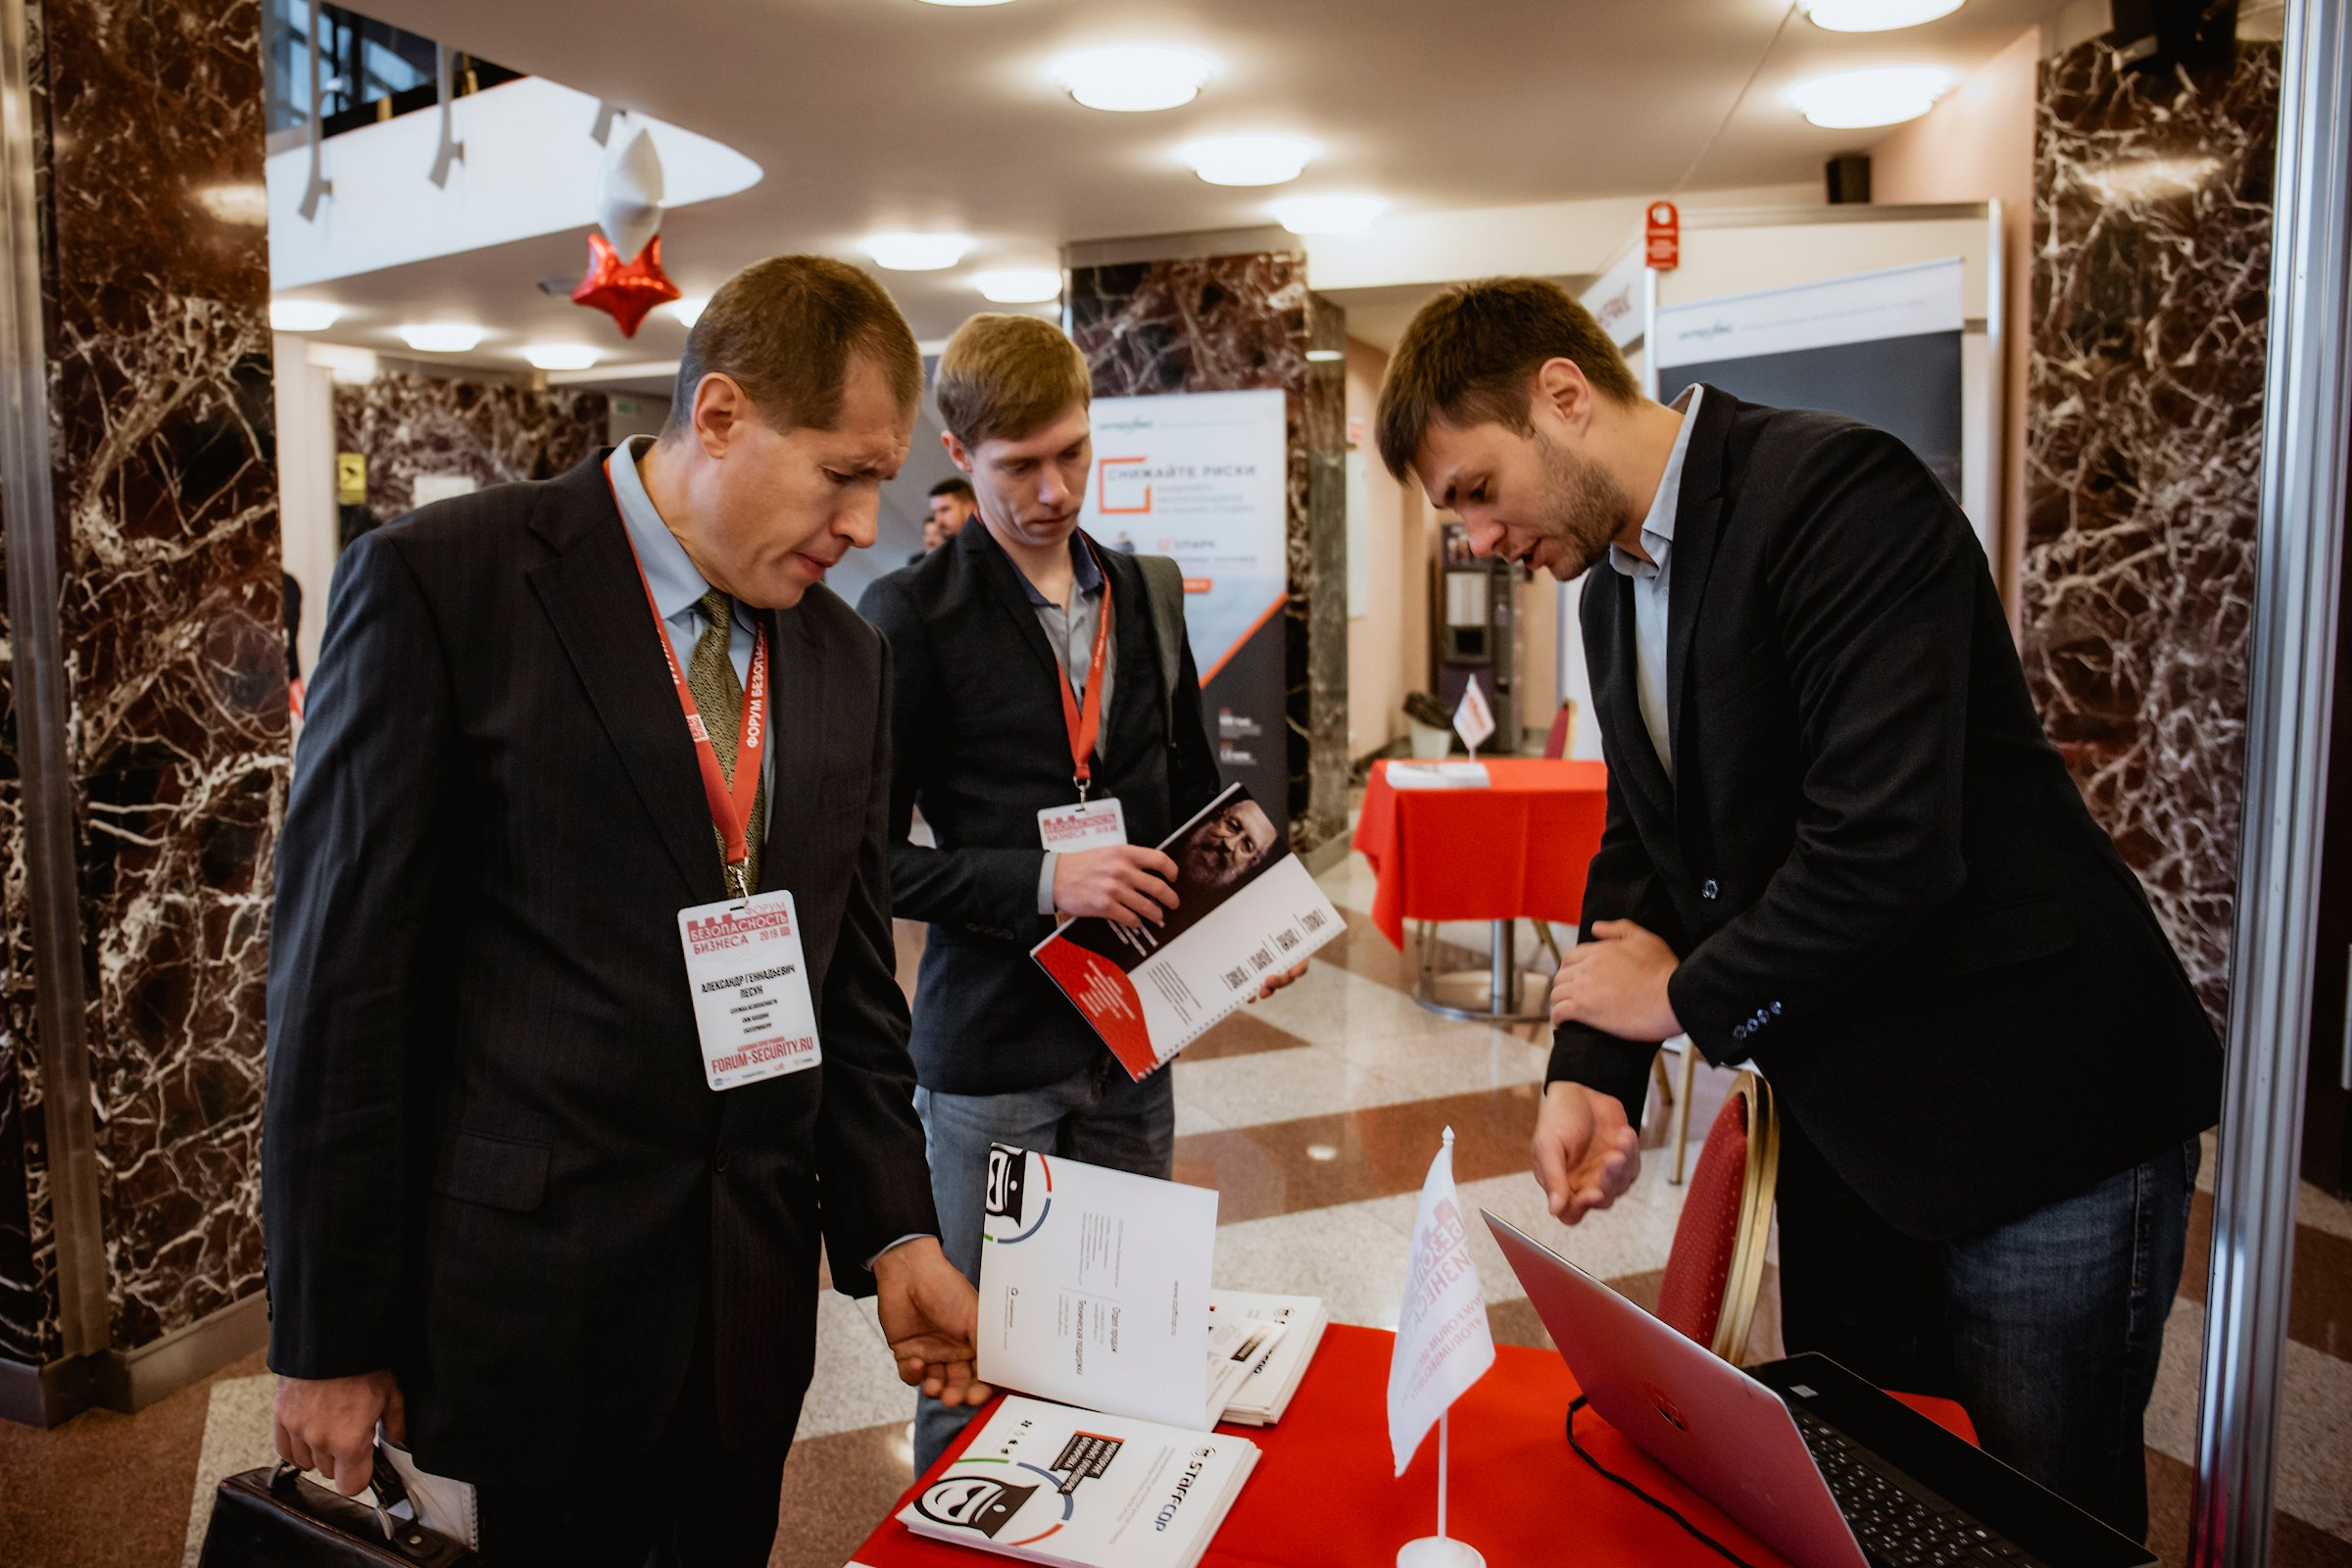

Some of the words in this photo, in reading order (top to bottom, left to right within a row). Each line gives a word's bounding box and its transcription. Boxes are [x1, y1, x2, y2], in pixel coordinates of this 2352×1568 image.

[1108, 466, 1196, 481] СНИЖАЙТЕ
[1202, 465, 1256, 477] РИСКИ
[751, 621, 765, 698] БЕЗОПАС
[746, 699, 762, 749] ФОРУМ
[745, 902, 785, 915] ФОРУМ
[690, 912, 788, 941] БЕЗОПАСНОСТЬ
[694, 935, 750, 955] БИЗНЕСА
[702, 975, 744, 994] АЛЕКСАНДР
[745, 964, 796, 985] ГЕННАДЬЕВИЧ
[711, 1036, 813, 1074] FORUM-SECURITY.RU
